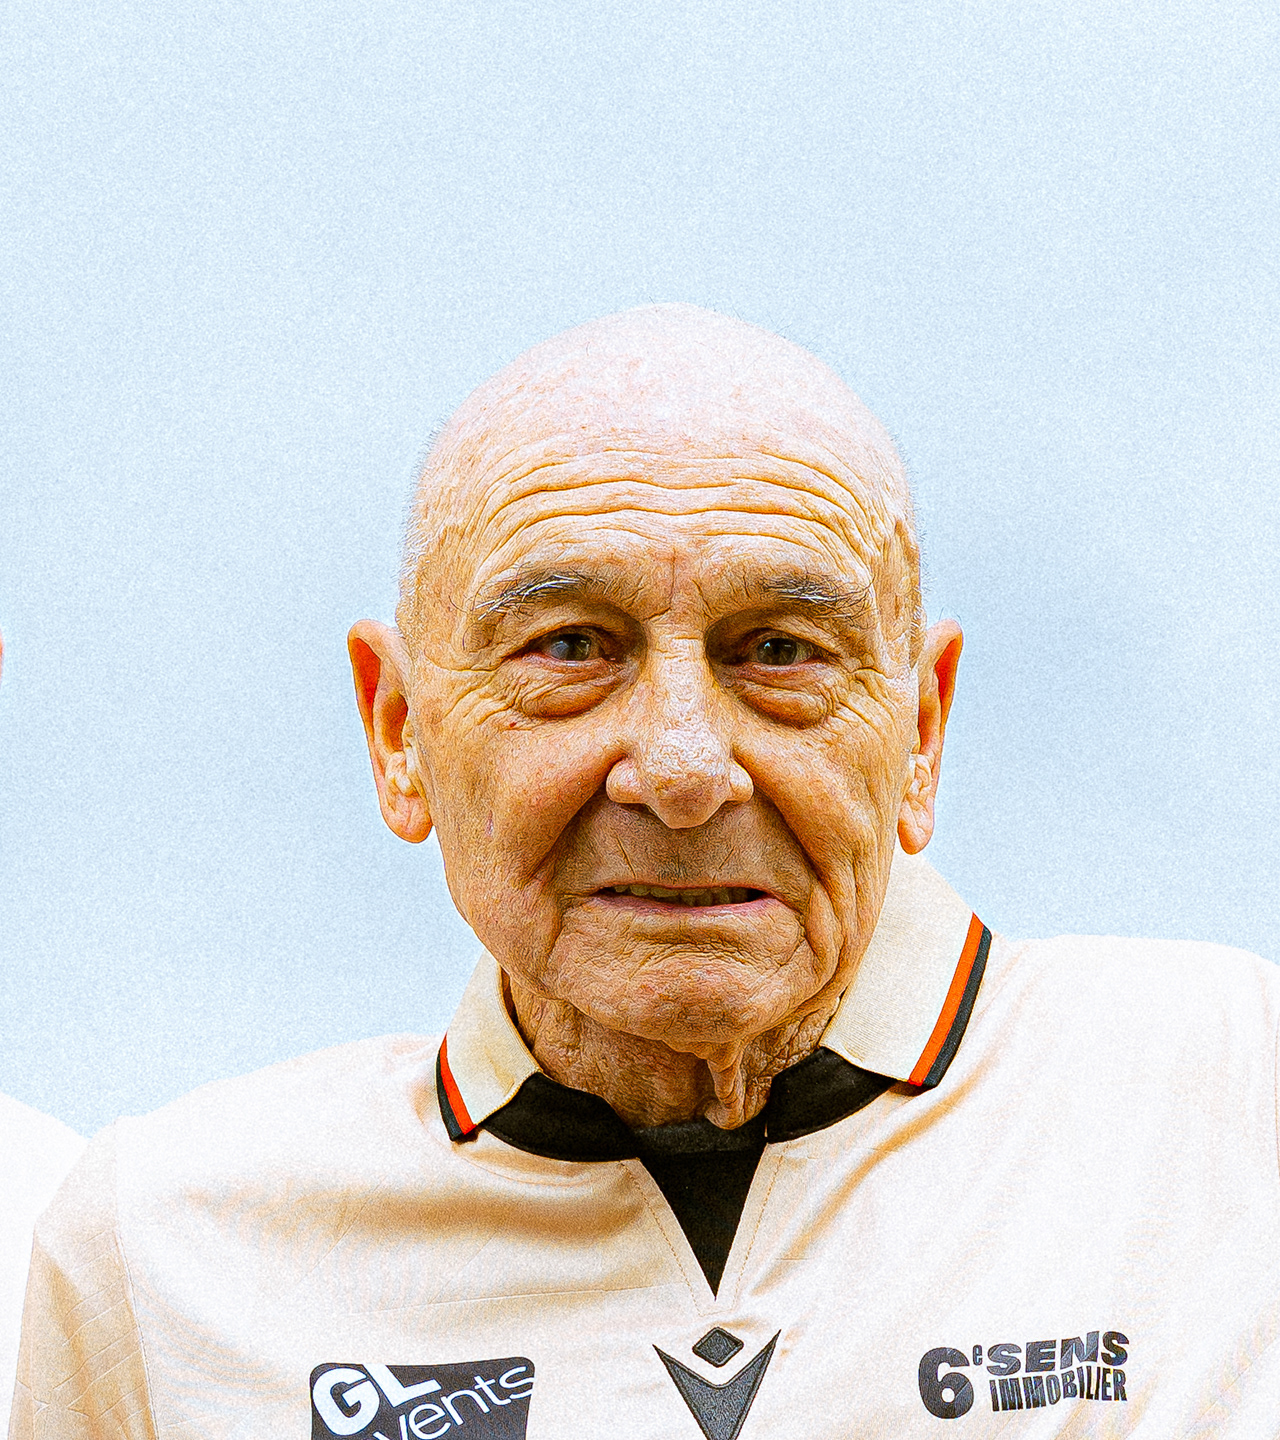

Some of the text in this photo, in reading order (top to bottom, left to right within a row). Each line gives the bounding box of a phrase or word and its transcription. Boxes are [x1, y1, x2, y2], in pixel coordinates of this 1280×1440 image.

[987, 1330, 1130, 1376] SENS
[312, 1363, 442, 1436] GL
[989, 1366, 1128, 1412] IMMOBILIER
